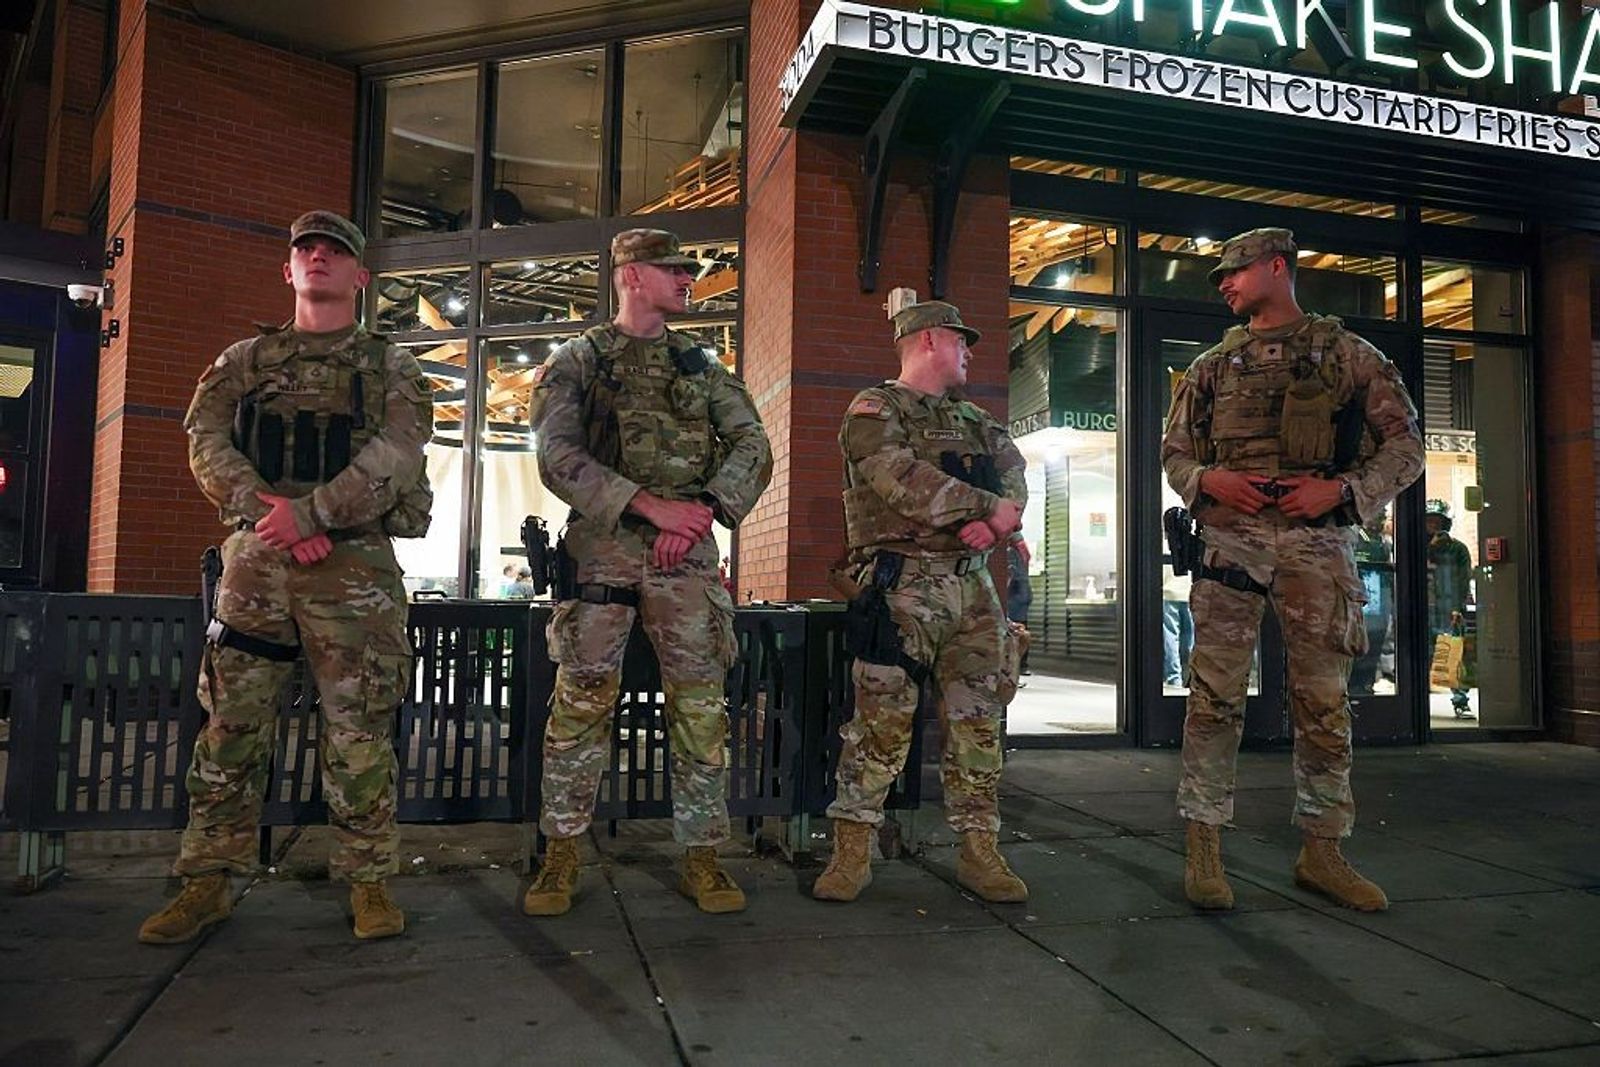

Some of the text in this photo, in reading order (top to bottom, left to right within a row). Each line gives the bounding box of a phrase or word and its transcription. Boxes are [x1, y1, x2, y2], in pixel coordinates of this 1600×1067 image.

[1066, 0, 1418, 68] AKE
[869, 11, 1085, 79] BURGERS
[1102, 48, 1272, 108] FROZEN
[1284, 78, 1461, 135] CUSTARD
[1475, 107, 1571, 153] FRIES
[1063, 411, 1117, 431] BURG
